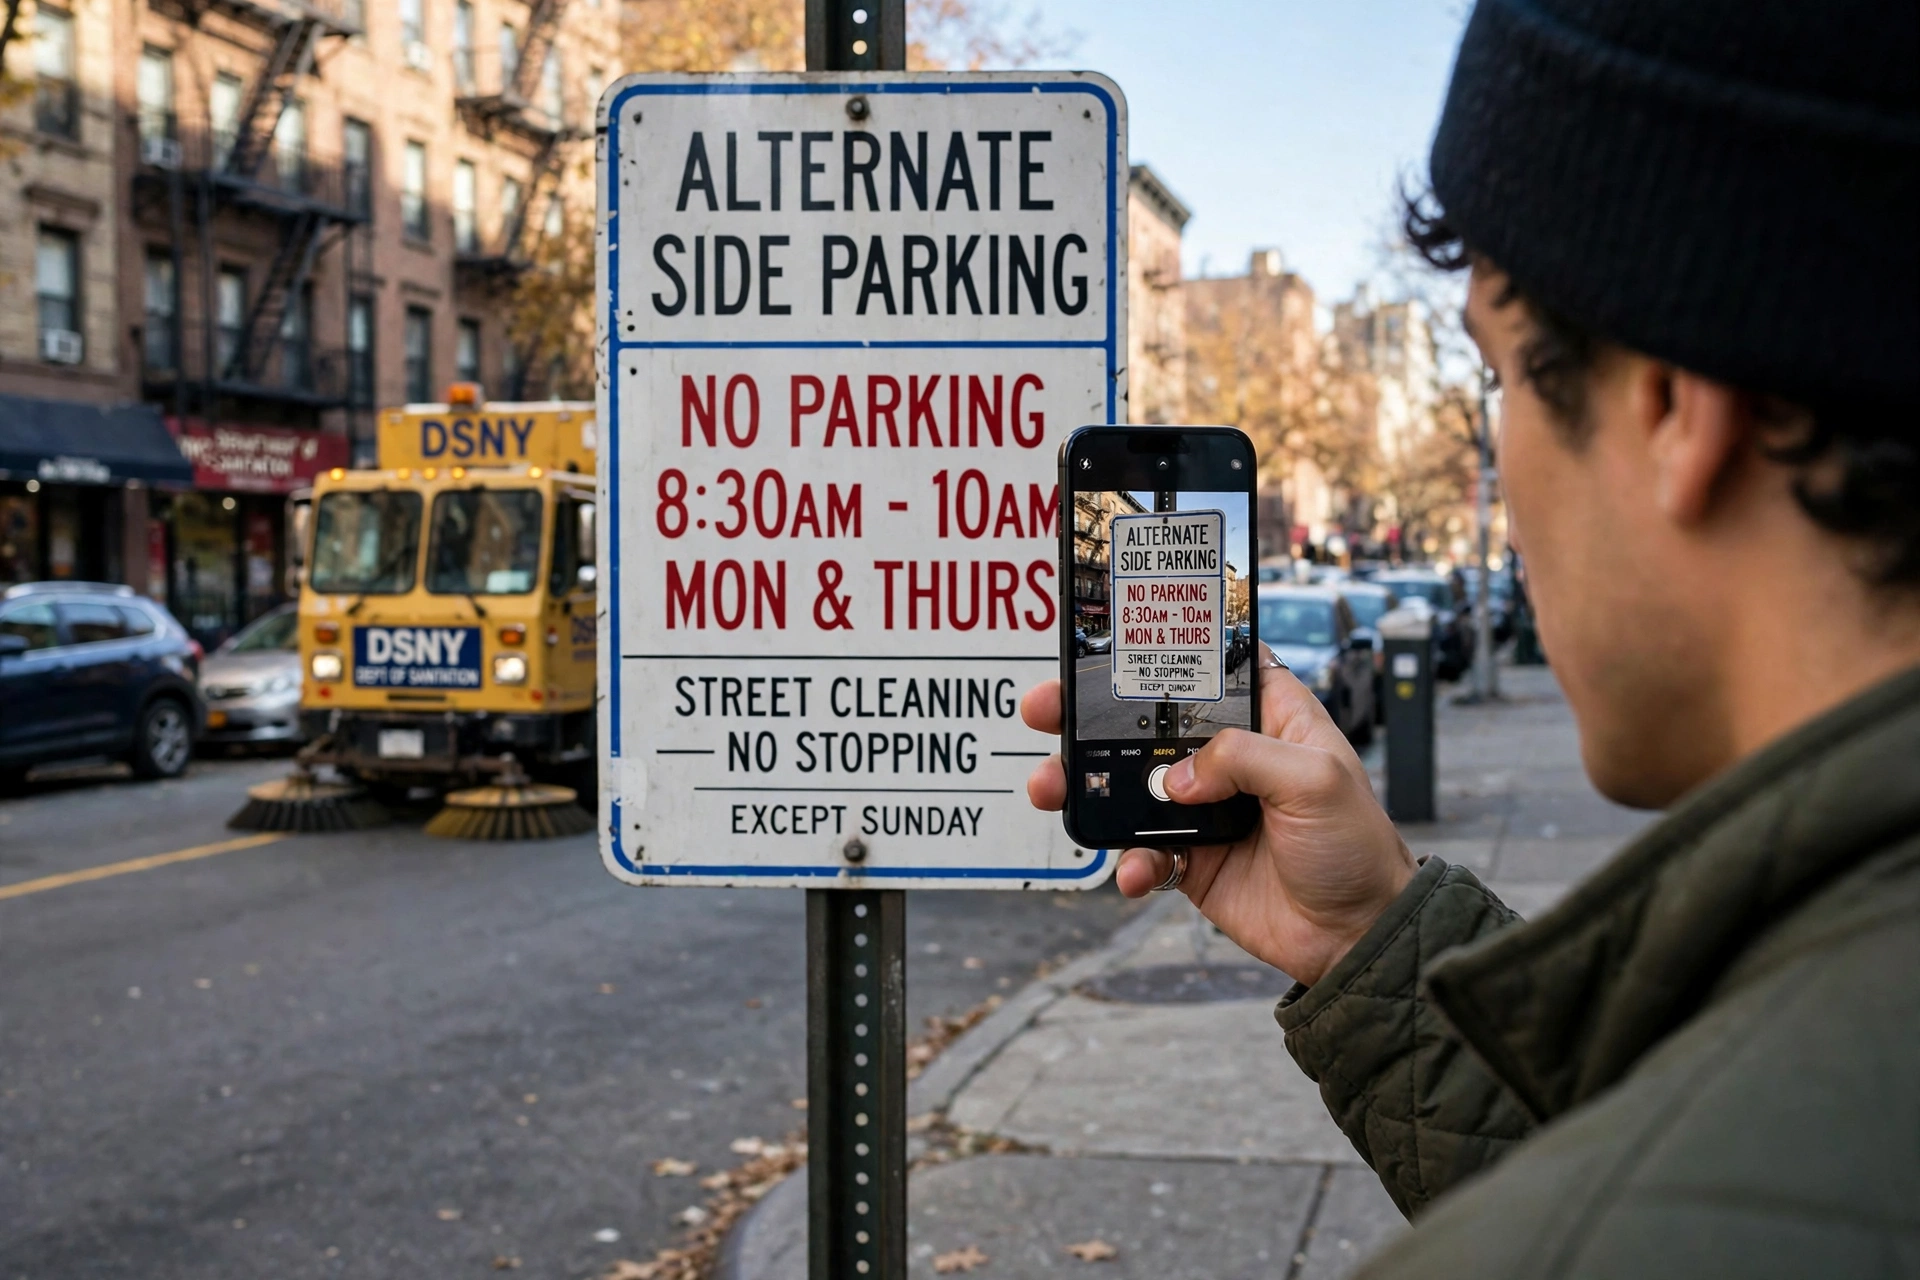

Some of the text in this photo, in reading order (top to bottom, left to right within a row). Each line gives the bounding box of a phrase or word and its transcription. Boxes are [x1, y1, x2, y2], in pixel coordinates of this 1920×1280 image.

[676, 131, 1054, 212] ALTERNATE
[651, 233, 1088, 317] SIDE PARKING
[681, 373, 1045, 449] NO PARKING
[420, 418, 535, 458] DSNY
[656, 468, 862, 540] 8:30AM
[932, 468, 1058, 540] 10AM
[1126, 524, 1209, 546] ALTERNATE
[1121, 549, 1217, 571] SIDE PARKING
[666, 559, 786, 631] MON
[812, 559, 854, 632] &
[873, 559, 1056, 632] THURS
[1127, 584, 1208, 602] NO PARKING
[1122, 606, 1168, 624] 8:30AM
[1182, 606, 1212, 623] 10AM
[366, 628, 467, 666] DSNY
[1125, 627, 1211, 645] MON & THURS
[1127, 653, 1157, 665] STREET
[1139, 667, 1195, 678] NO STOPPING
[675, 676, 1016, 719] STREET CLEANING
[728, 731, 978, 774] NO STOPPING
[731, 805, 984, 837] EXCEPT SUNDAY
